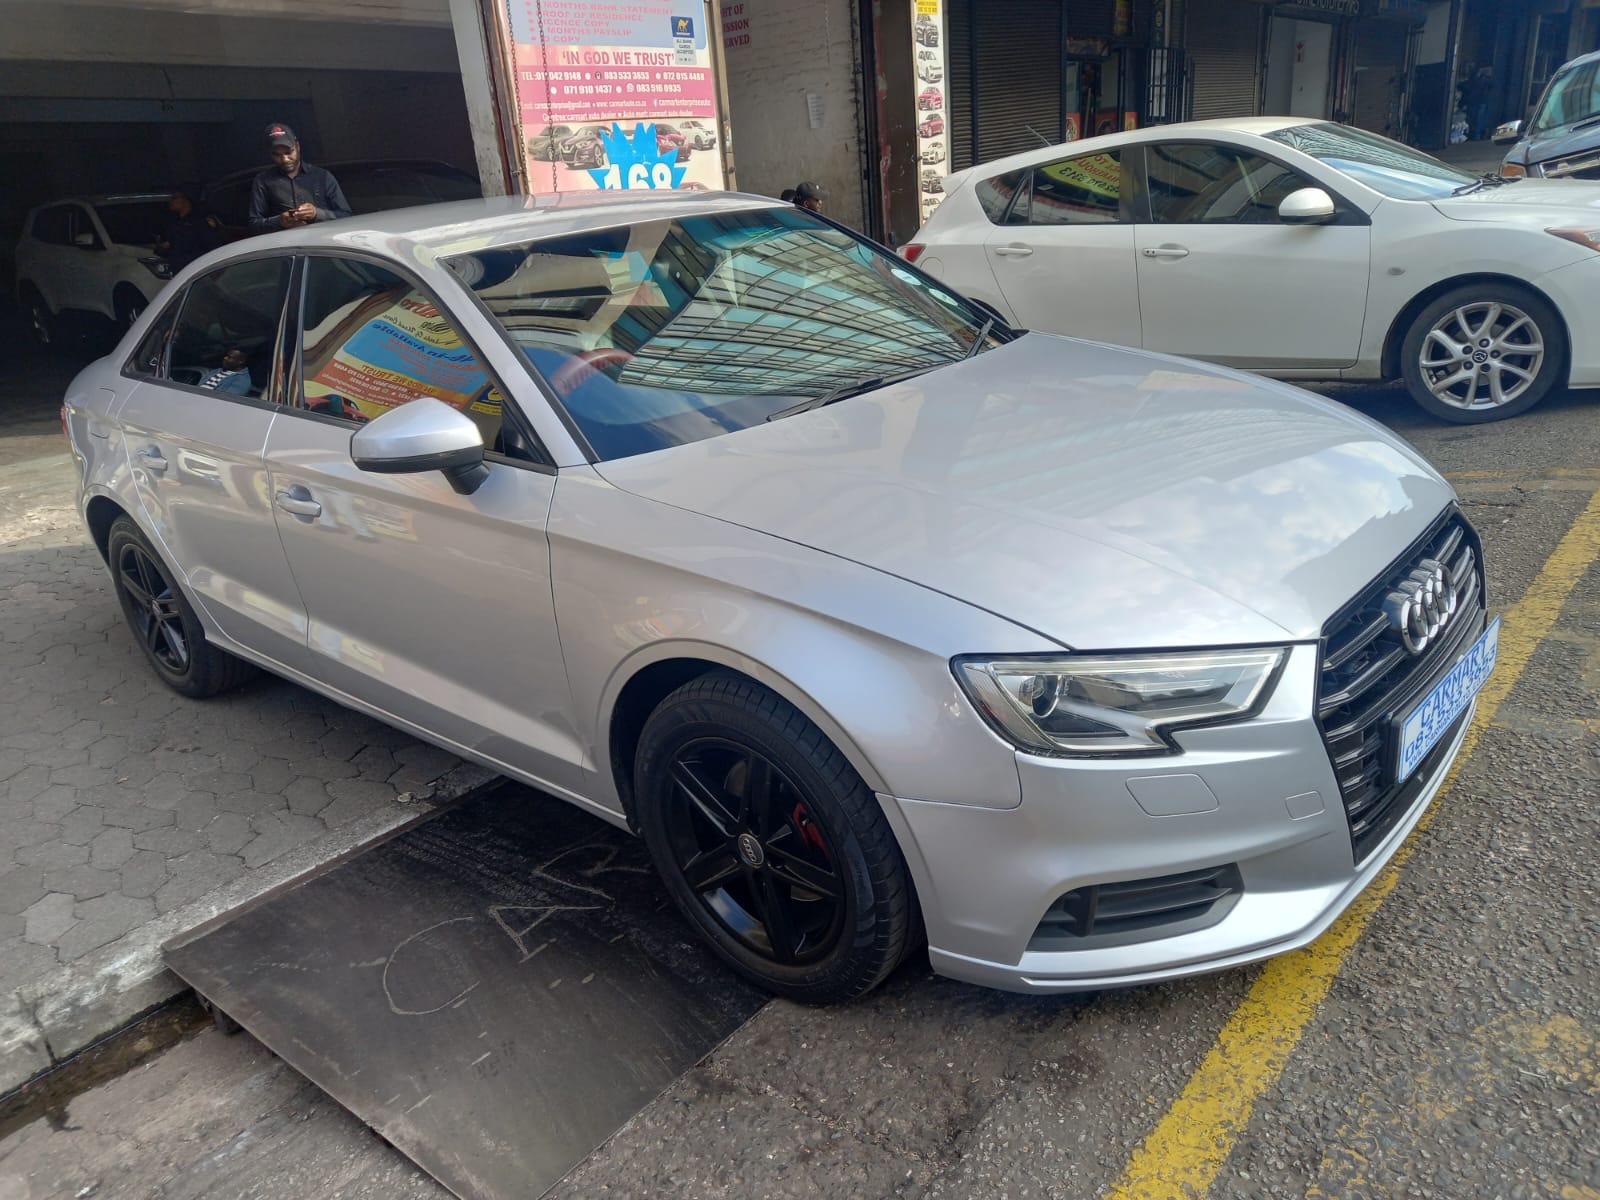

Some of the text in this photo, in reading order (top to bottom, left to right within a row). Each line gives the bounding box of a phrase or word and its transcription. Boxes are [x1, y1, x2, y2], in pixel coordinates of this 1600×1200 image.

[544, 1, 587, 9] MONTHS
[621, 5, 673, 15] STATEMENT
[734, 3, 744, 15] OF
[548, 27, 632, 36] MONTHS PAYSLIP
[724, 18, 749, 32] ISSION
[584, 51, 610, 65] GOD
[613, 52, 632, 65] WE
[1420, 633, 1488, 731] CARMART
